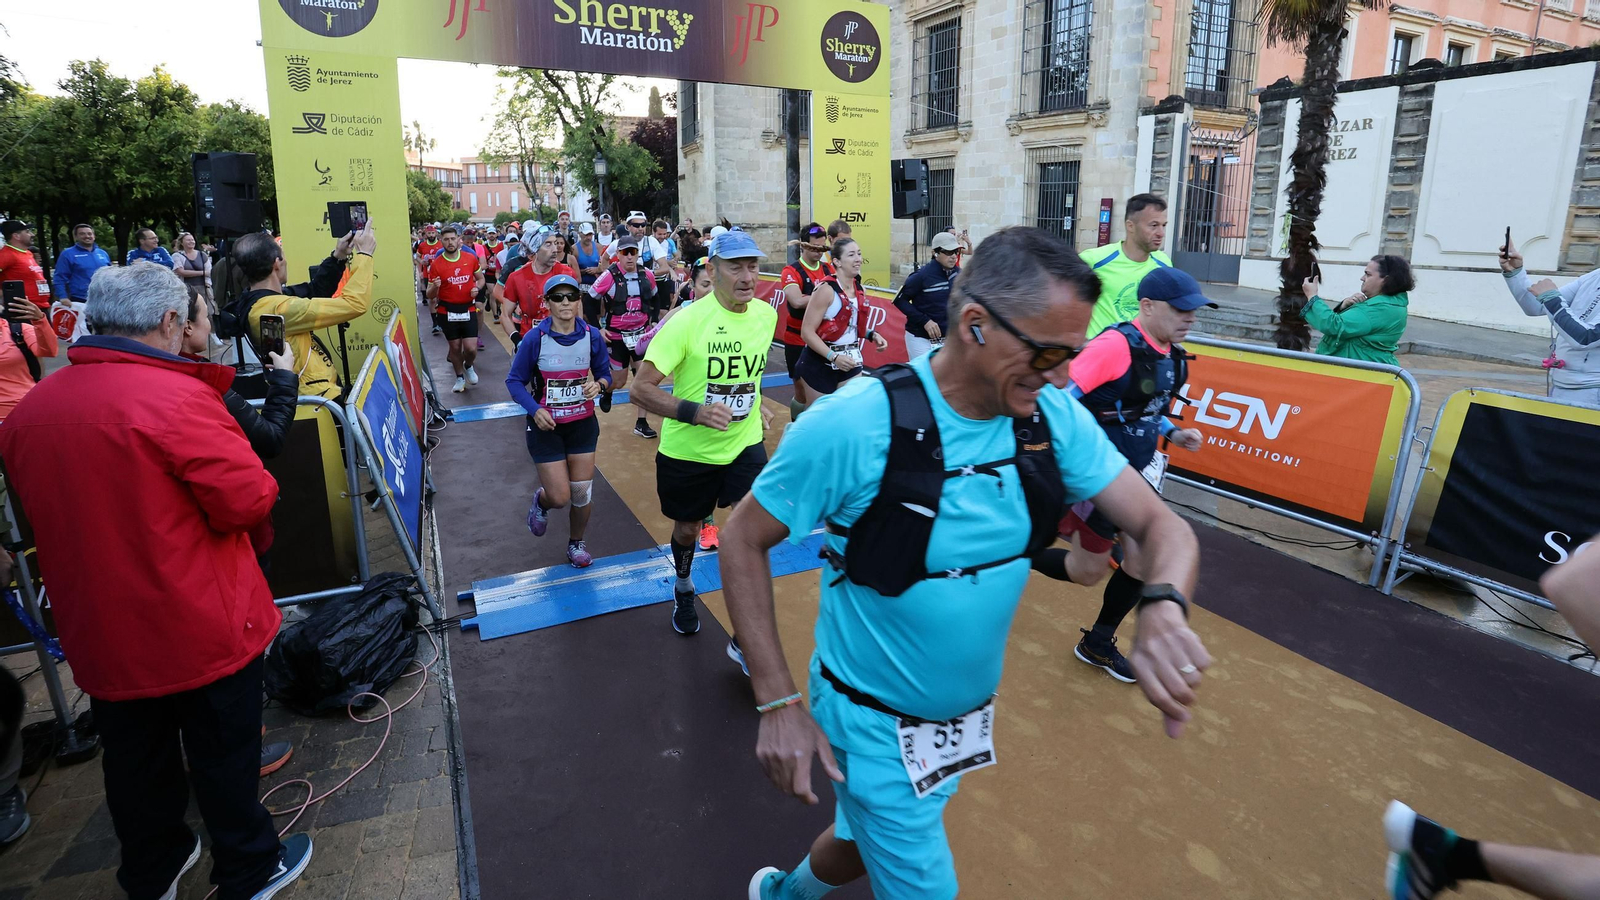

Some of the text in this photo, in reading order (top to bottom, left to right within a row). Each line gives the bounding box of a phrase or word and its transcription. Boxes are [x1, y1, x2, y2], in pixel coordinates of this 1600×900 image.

[554, 0, 694, 49] Sherry
[580, 26, 673, 53] Maratón
[825, 37, 877, 62] Sherry
[834, 52, 869, 63] Maratón
[316, 68, 379, 79] Ayuntamiento
[316, 76, 353, 86] de Jerez
[842, 105, 880, 113] Ayuntamiento
[330, 113, 383, 125] Diputación
[1329, 117, 1374, 133] AZAR
[331, 126, 374, 137] de Cádiz
[847, 138, 880, 148] Diputación
[857, 148, 874, 157] Cádiz
[839, 212, 867, 222] HSN
[708, 341, 742, 354] IMMO
[560, 387, 577, 397] 103
[722, 395, 744, 408] 176
[1207, 436, 1301, 467] NUTRITION!
